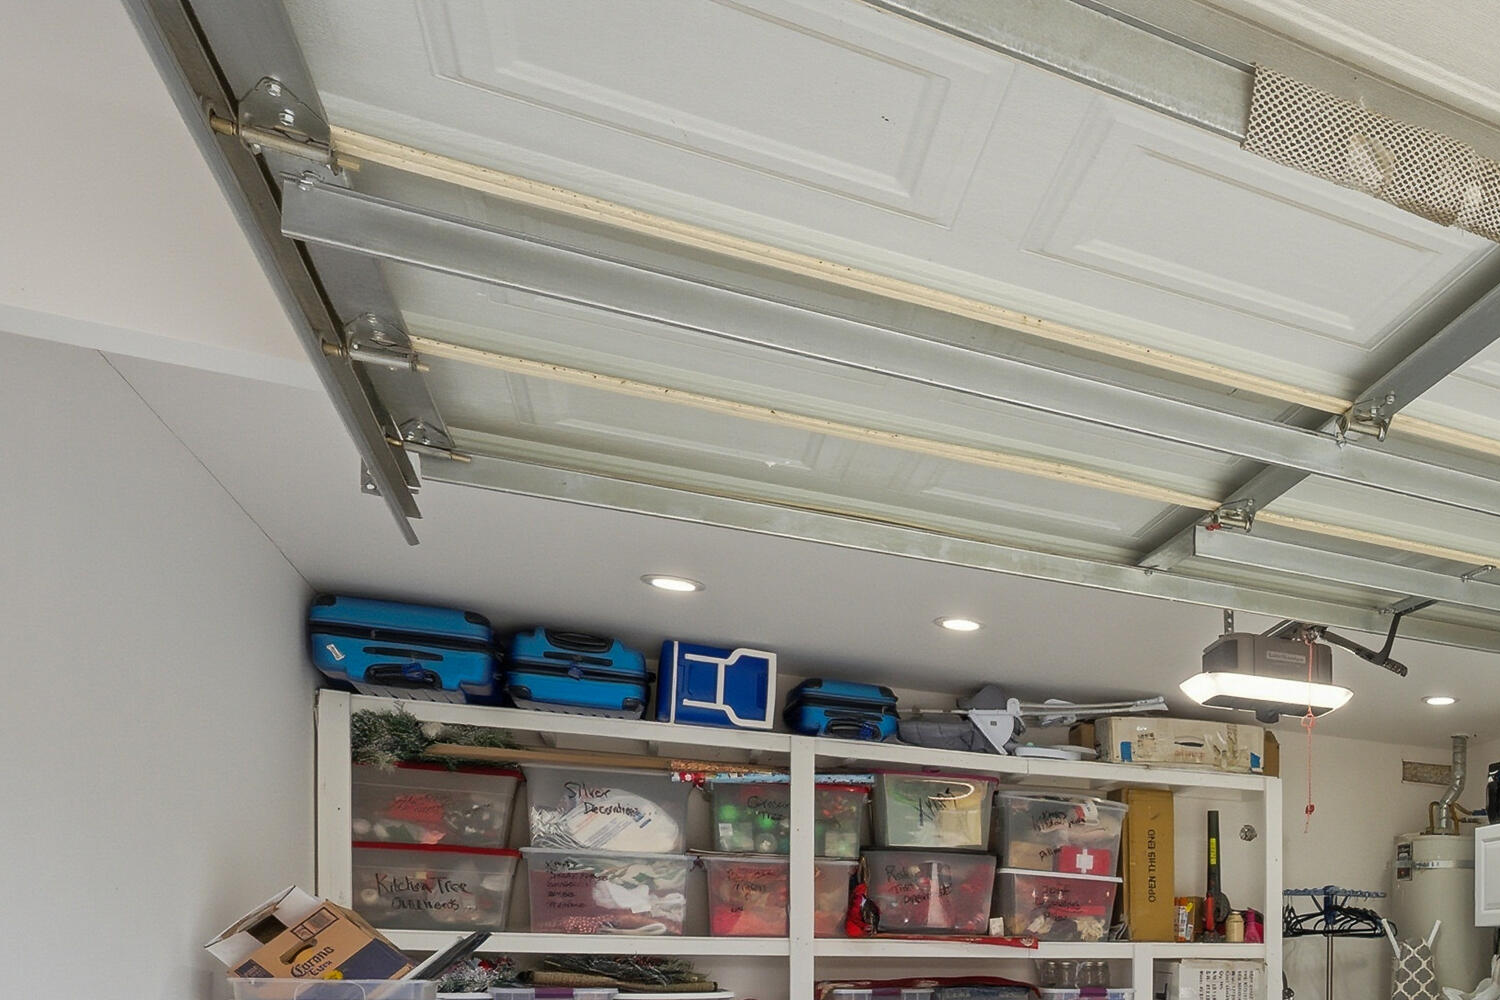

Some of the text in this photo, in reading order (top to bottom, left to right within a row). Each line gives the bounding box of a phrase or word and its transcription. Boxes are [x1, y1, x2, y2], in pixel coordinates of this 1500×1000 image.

[564, 781, 611, 799] Silver
[1147, 828, 1157, 903] OPEN THIS END
[291, 946, 335, 977] Corona
